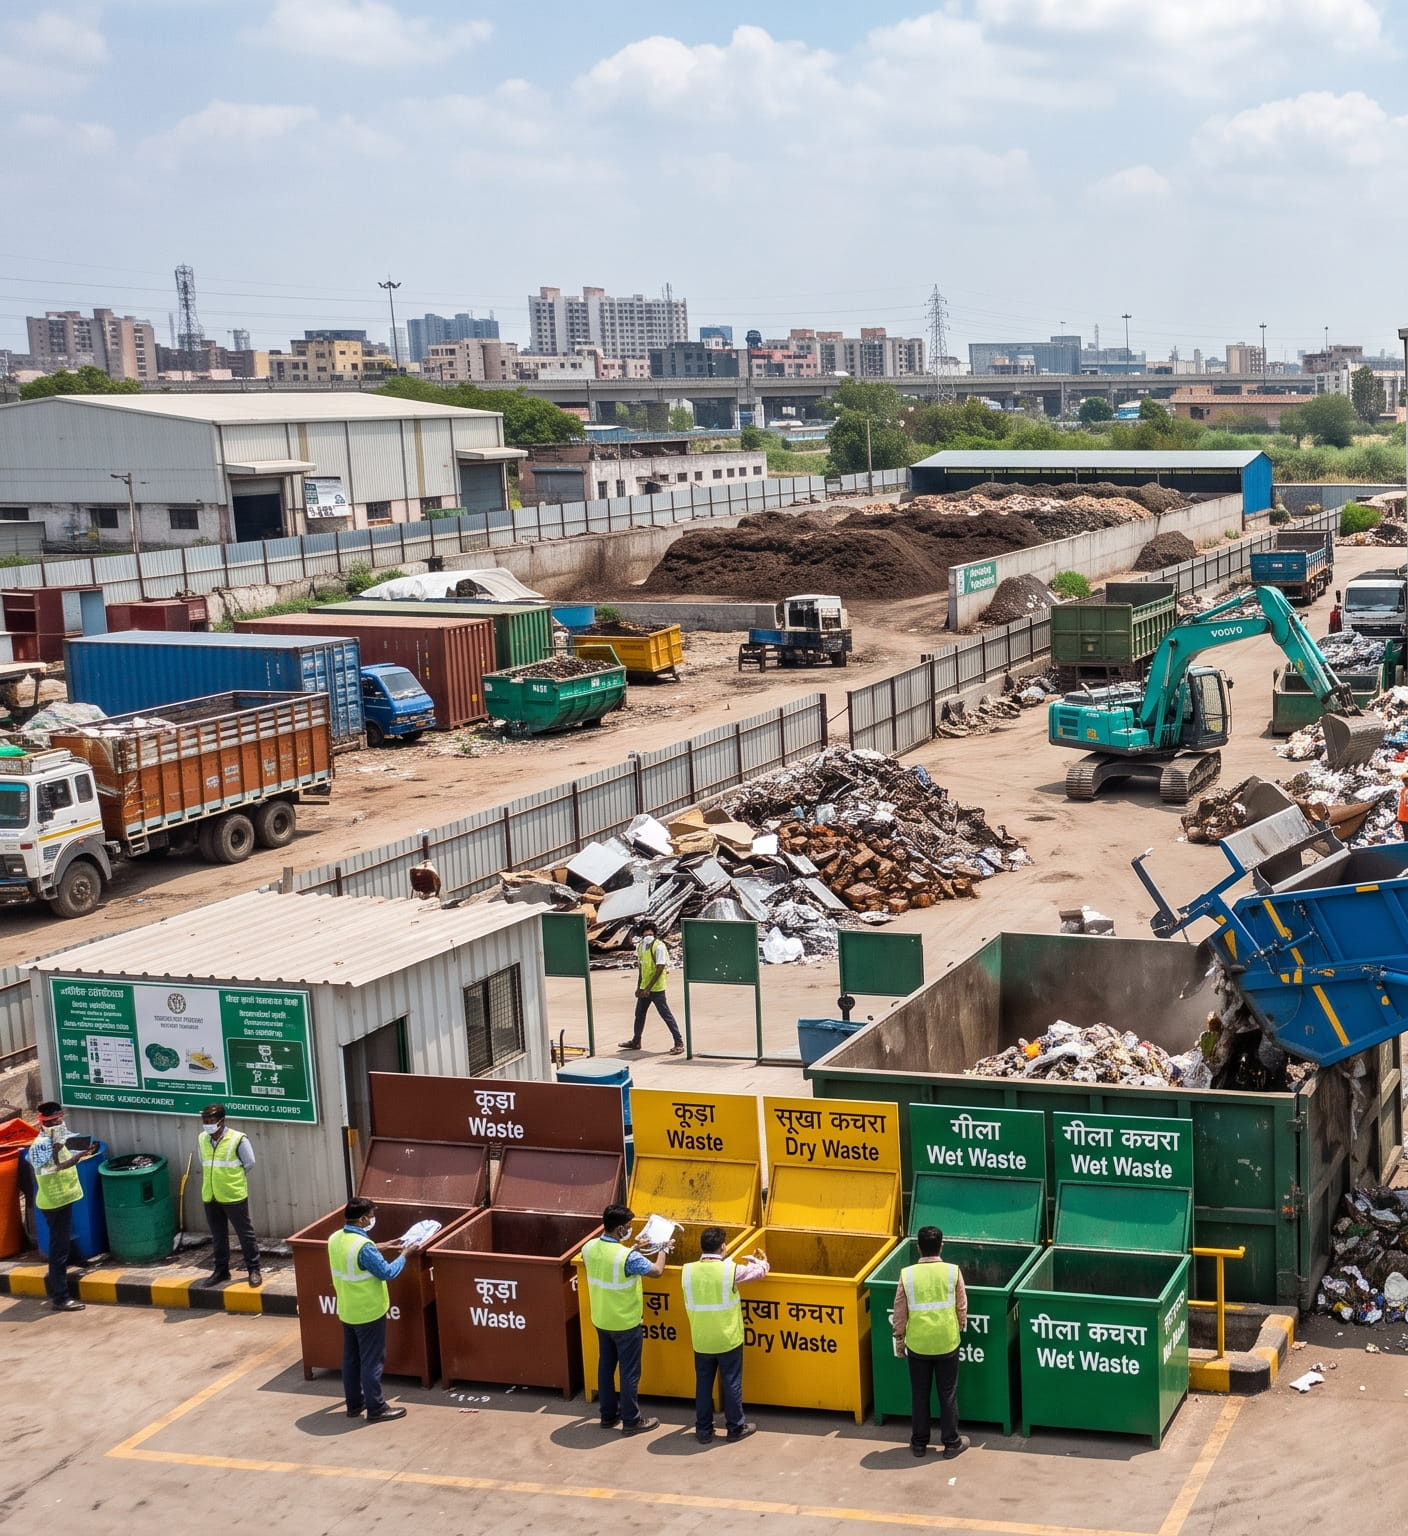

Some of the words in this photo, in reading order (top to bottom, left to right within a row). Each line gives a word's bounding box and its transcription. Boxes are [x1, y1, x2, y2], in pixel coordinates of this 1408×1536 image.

[473, 1090, 516, 1115] कूड़ा
[672, 1102, 715, 1128] कूड़ा
[468, 1117, 524, 1139] Waste
[774, 1108, 822, 1135] सूखा
[829, 1111, 886, 1134] कचरा
[950, 1113, 1001, 1141] गीला
[667, 1129, 723, 1152] Waste
[1062, 1120, 1113, 1147] गीला
[1120, 1129, 1180, 1151] कचरा
[785, 1137, 816, 1162] Dry
[822, 1139, 879, 1161] Waste
[926, 1145, 964, 1166] Wet
[968, 1147, 1027, 1170] Waste
[1070, 1154, 1108, 1175] Wet
[1113, 1156, 1173, 1179] Waste
[474, 1278, 518, 1304] कूड़ा
[470, 1307, 526, 1329] Waste
[787, 1302, 844, 1324] कचरा
[642, 1322, 677, 1341] aste
[744, 1328, 775, 1353] Dry
[780, 1330, 838, 1353] Waste
[1030, 1313, 1081, 1341] गीला
[1087, 1322, 1148, 1346] कचरा
[959, 1343, 985, 1363] ste
[1036, 1348, 1075, 1370] Wet
[1080, 1351, 1140, 1375] Waste
